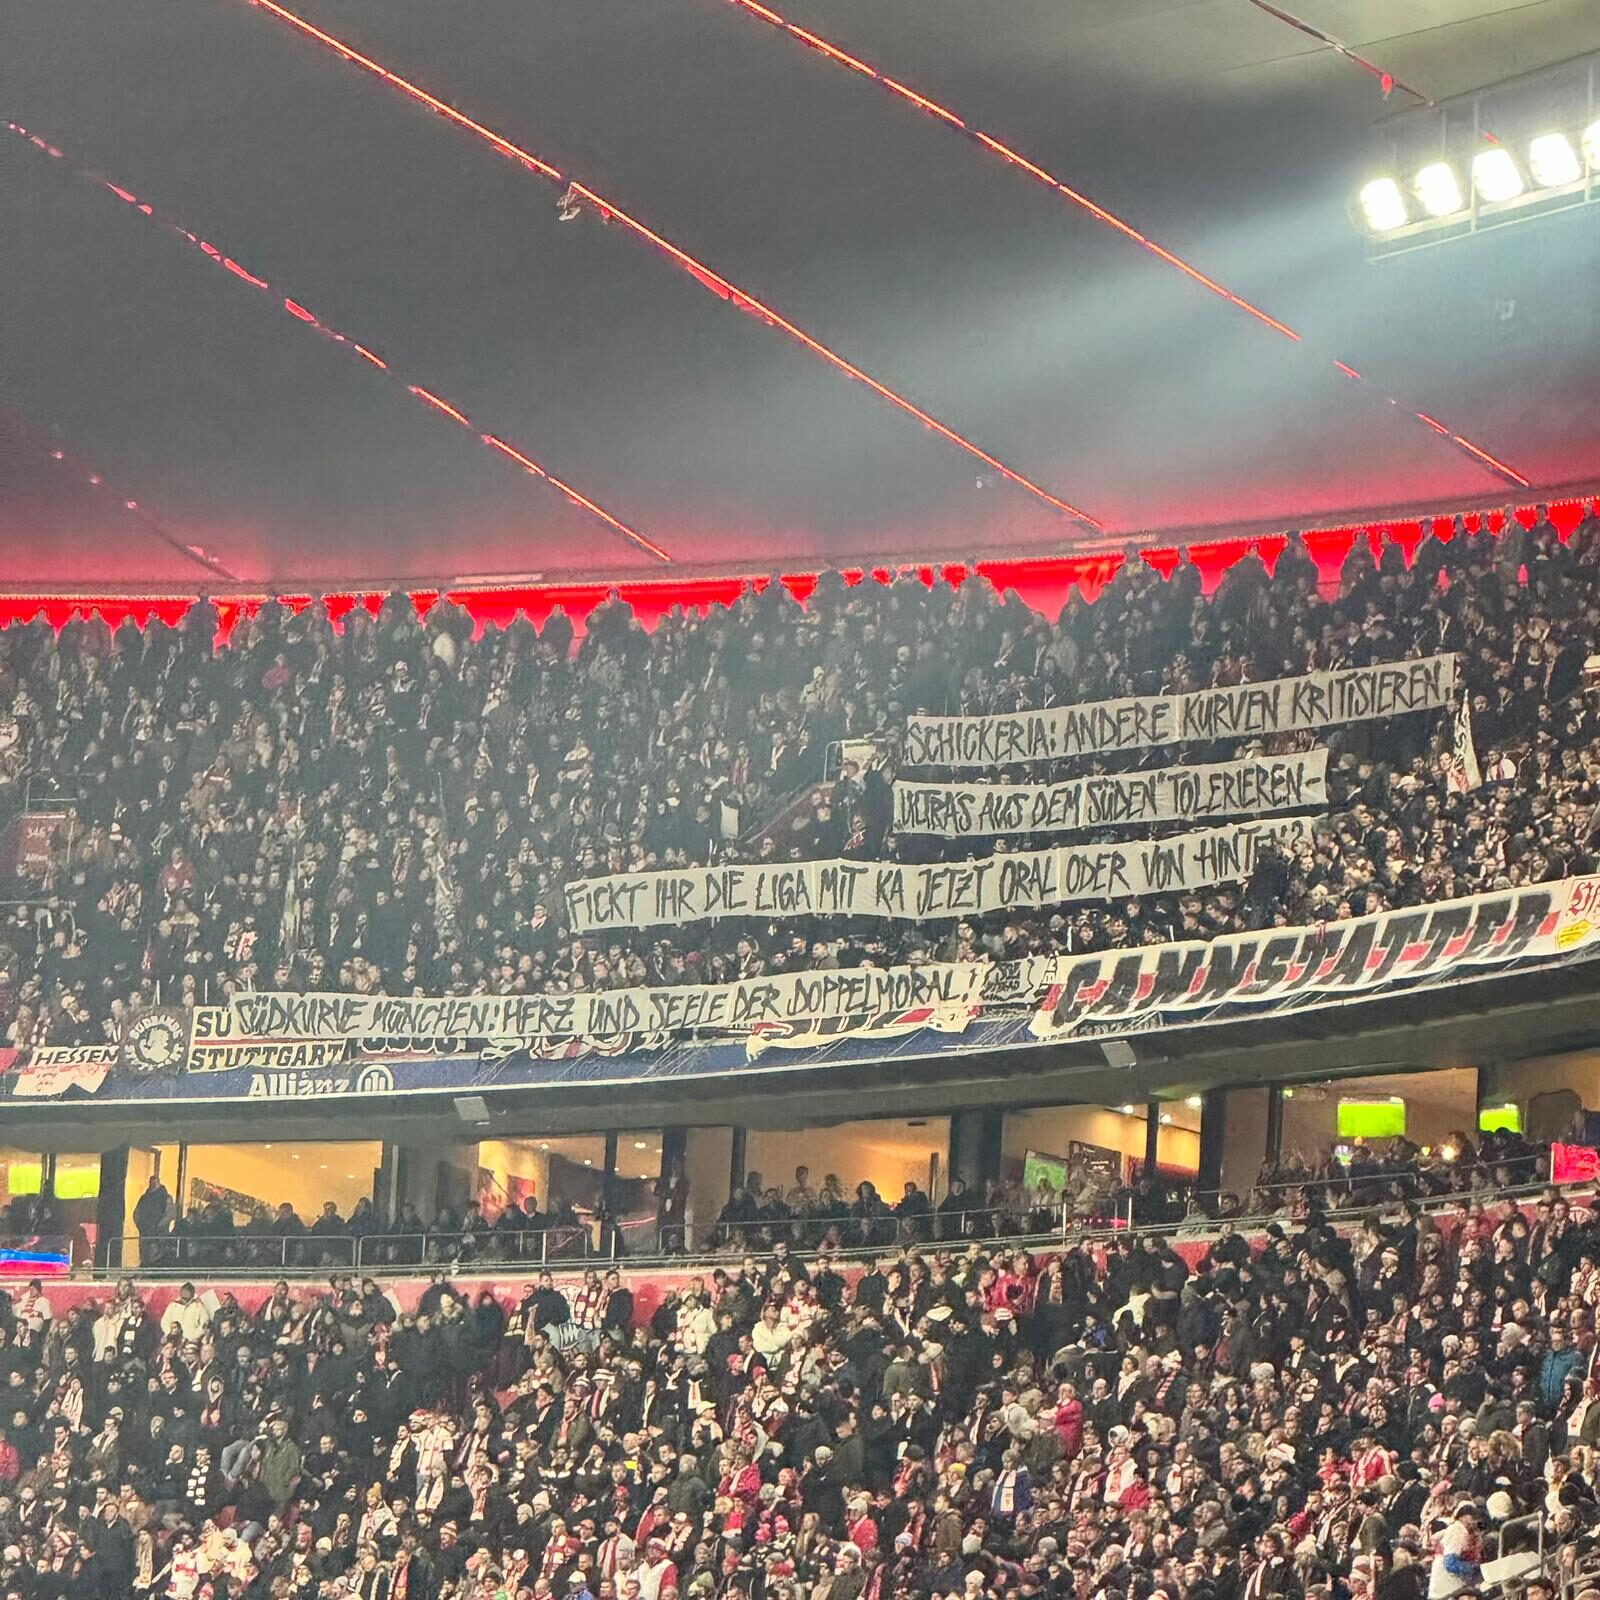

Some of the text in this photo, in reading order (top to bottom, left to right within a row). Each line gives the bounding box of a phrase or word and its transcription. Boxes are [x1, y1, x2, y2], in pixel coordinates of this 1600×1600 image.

[1063, 702, 1171, 753] ANDERE
[1182, 684, 1281, 737] KURVEN
[978, 791, 1030, 831] AUS
[1030, 783, 1082, 828] DEM
[565, 881, 649, 929] FICKT
[655, 877, 698, 919] IHR
[703, 870, 748, 912] DIE
[754, 868, 811, 911] LIGA
[818, 865, 869, 910] MIT
[875, 867, 905, 913] KA
[915, 861, 994, 914] JETZT
[999, 858, 1059, 904] ORAL
[1065, 850, 1131, 895] ODER
[1141, 844, 1186, 888] VON
[235, 995, 369, 1036] SÜDKURVE
[502, 997, 576, 1035] HERZ
[587, 994, 640, 1033] UND
[649, 991, 729, 1031] SEELE
[731, 982, 782, 1023] DER
[786, 967, 977, 1015] DOPPELMORAL!
[34, 1048, 119, 1066] HESSEN
[189, 1044, 346, 1071] STUTTGART
